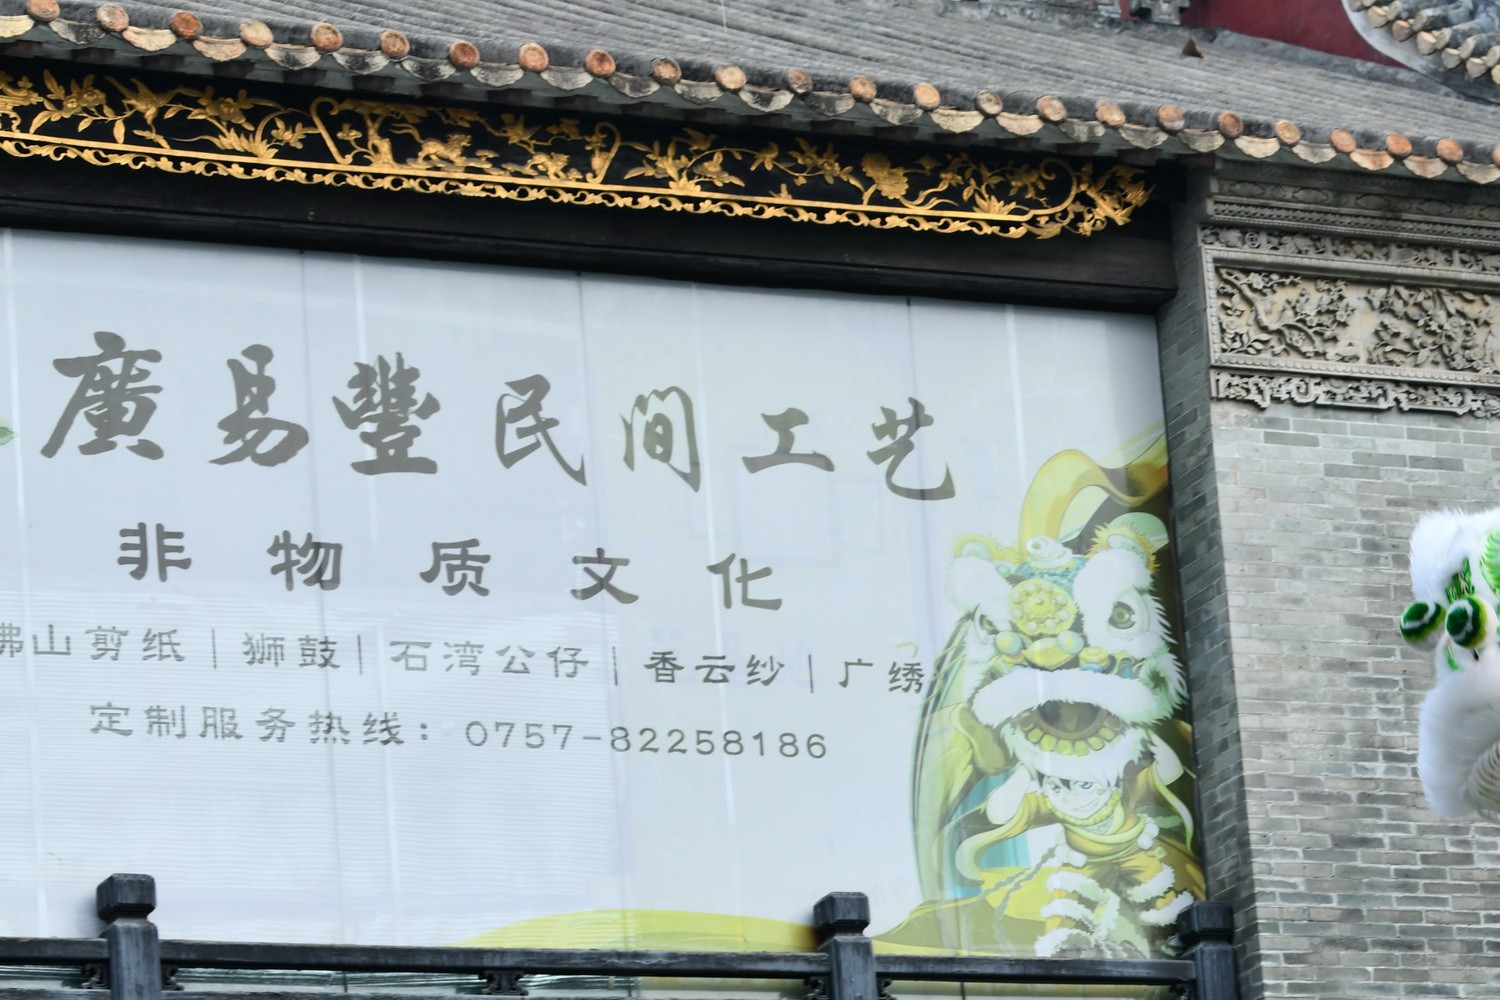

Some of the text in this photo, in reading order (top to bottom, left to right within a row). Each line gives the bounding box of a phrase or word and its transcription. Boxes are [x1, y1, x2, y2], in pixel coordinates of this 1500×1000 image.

[117, 522, 783, 611] 非物质文化
[242, 632, 340, 670] 狮鼓
[389, 640, 589, 679] 石湾公仔
[643, 650, 785, 687] 香云纱
[838, 658, 925, 694] 广绣
